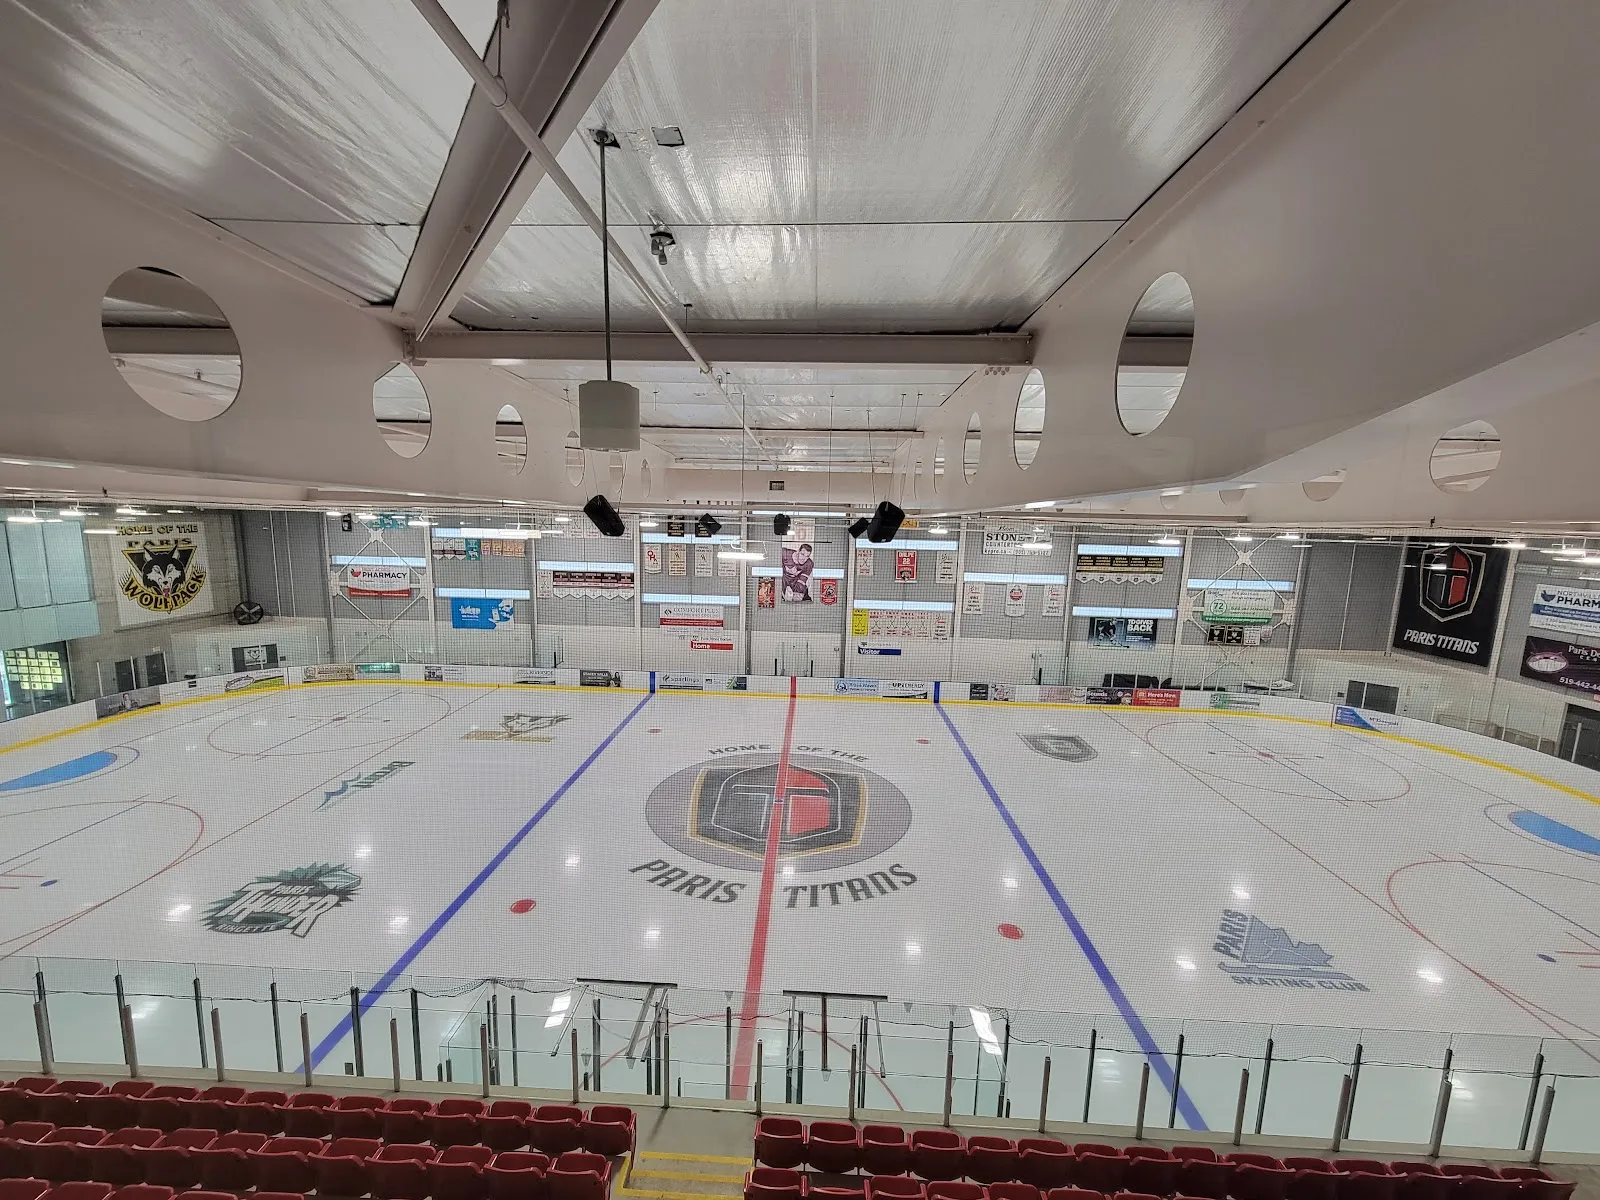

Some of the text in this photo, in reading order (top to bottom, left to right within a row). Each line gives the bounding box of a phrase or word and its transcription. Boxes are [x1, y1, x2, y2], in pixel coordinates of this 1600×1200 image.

[116, 524, 198, 535] HOME OF THE
[124, 572, 205, 609] WOLFPACK
[1214, 602, 1224, 610] 72
[1404, 629, 1480, 654] PARIS TITANS
[1568, 645, 1589, 656] Paris
[708, 744, 869, 763] HOME OF THE
[271, 884, 316, 895] PARIS
[628, 858, 918, 909] PARIS TITANS
[214, 881, 340, 939] THUNDER
[215, 923, 279, 934] RINGETTE
[1213, 908, 1249, 960] PARIS
[1231, 975, 1370, 992] SKATING CLUB
